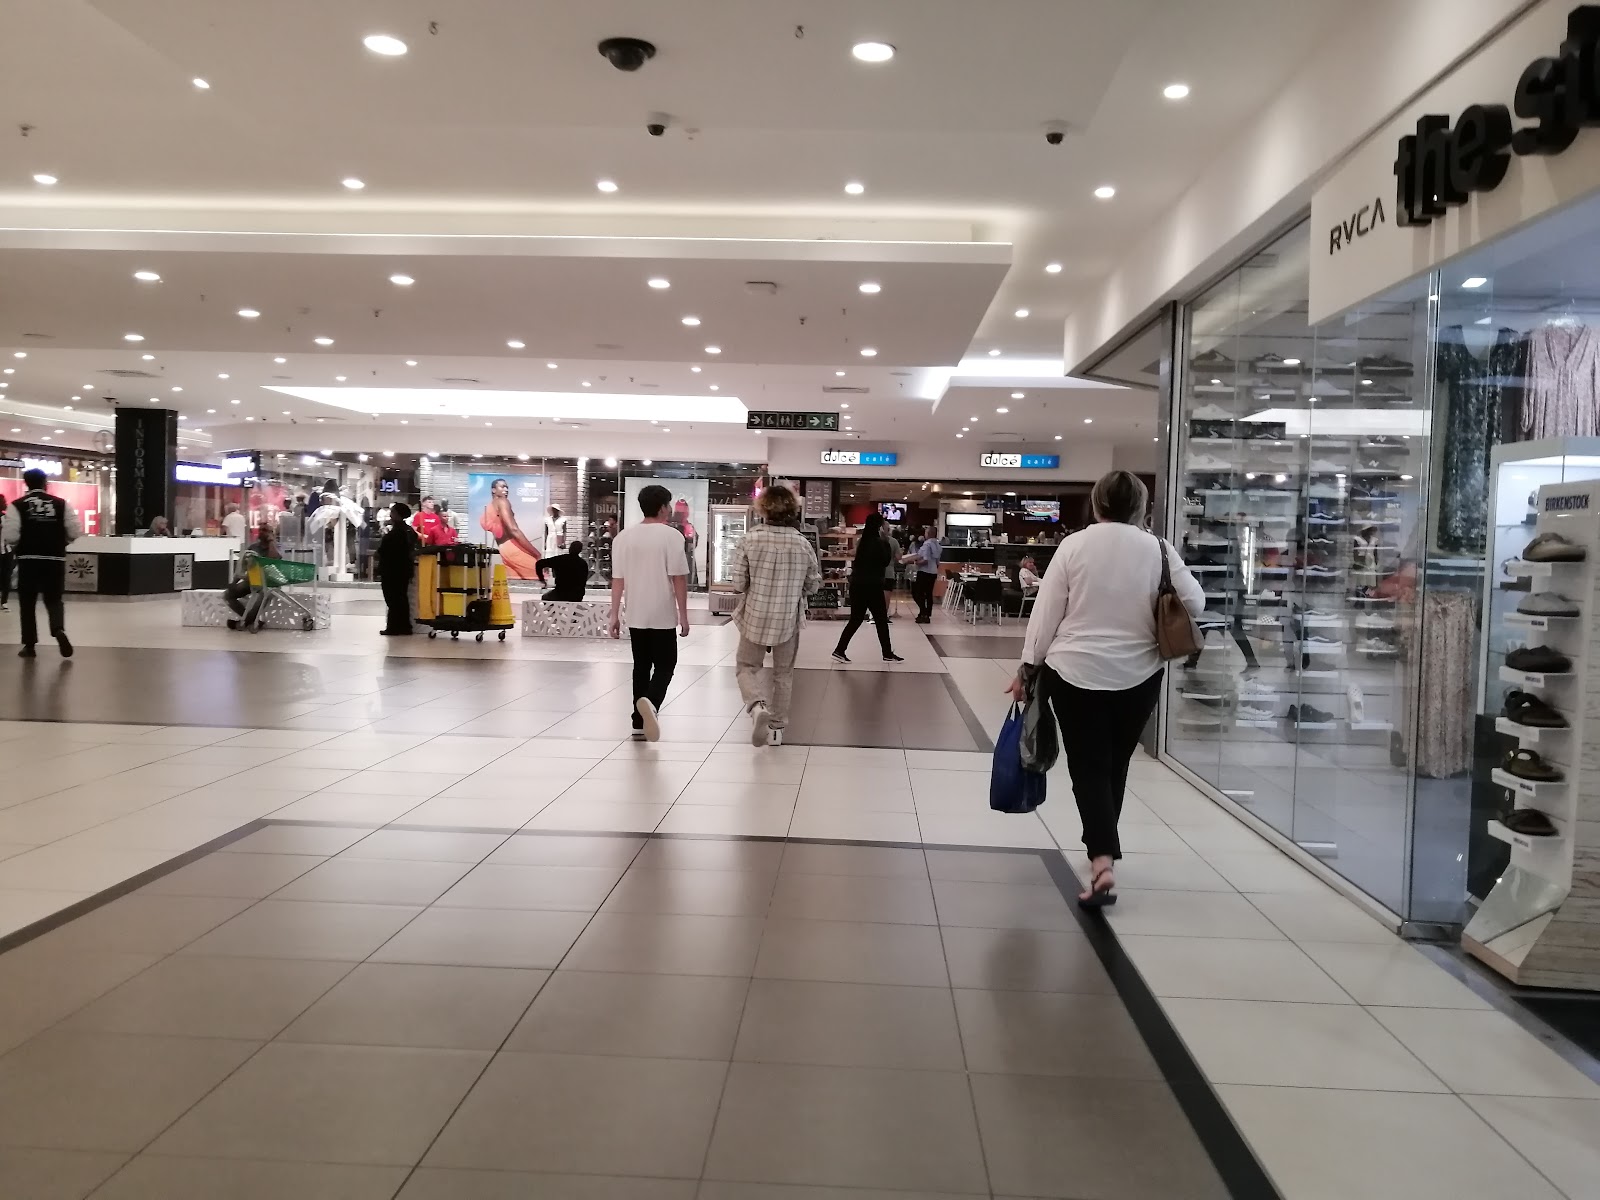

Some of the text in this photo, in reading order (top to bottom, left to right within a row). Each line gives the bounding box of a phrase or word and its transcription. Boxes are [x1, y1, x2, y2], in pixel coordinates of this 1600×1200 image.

[1394, 104, 1513, 227] the
[1329, 197, 1385, 255] RVCA
[134, 418, 145, 526] INFORMATION
[1545, 494, 1590, 511] BIRKENSTOCK
